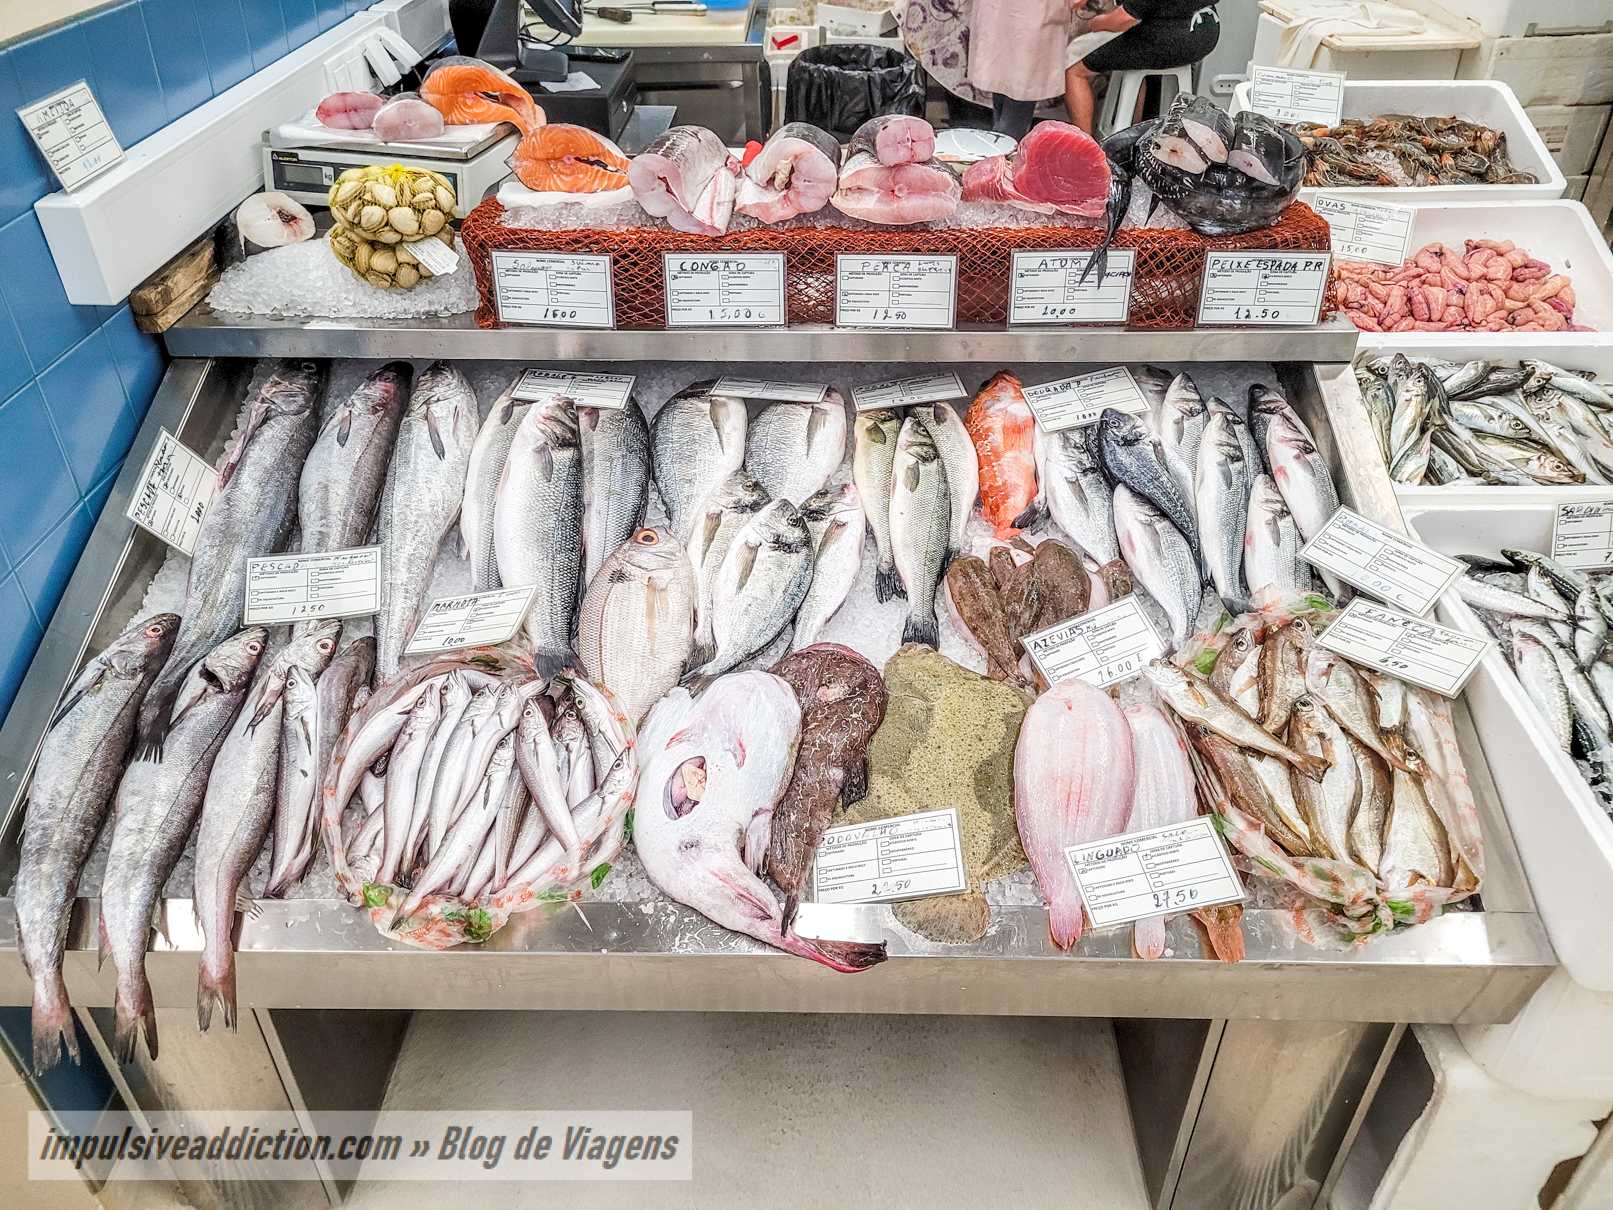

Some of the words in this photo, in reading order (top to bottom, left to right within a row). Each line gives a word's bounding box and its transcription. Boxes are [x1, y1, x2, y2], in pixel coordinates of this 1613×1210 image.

[324, 174, 333, 186] kg
[1318, 199, 1345, 210] OVAS
[861, 261, 910, 272] PERCA
[1211, 259, 1252, 269] PEIXE
[1256, 258, 1297, 270] ESPADA
[433, 597, 478, 610] MARMOTA
[1033, 625, 1083, 651] AZEVIAS
[1074, 844, 1140, 864] LINGUADO
